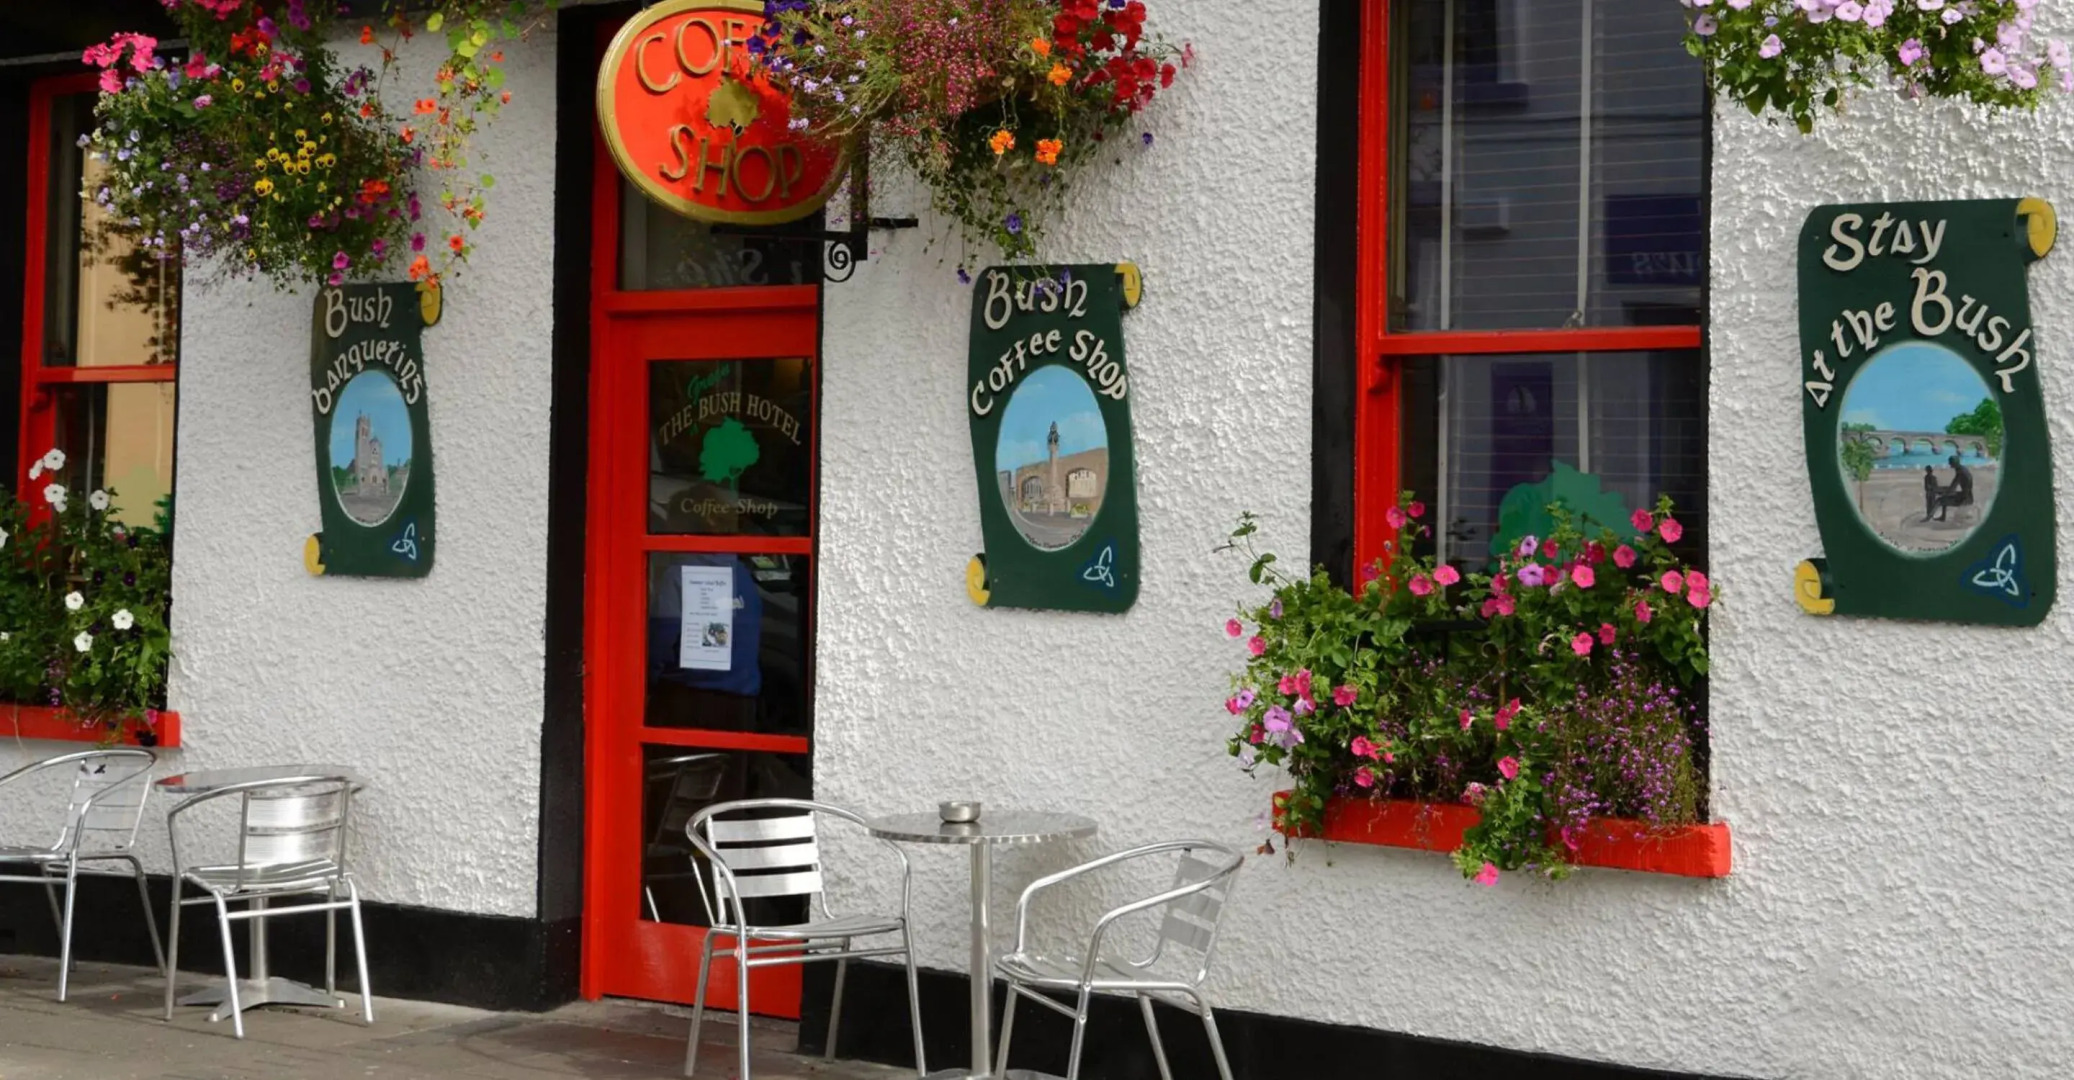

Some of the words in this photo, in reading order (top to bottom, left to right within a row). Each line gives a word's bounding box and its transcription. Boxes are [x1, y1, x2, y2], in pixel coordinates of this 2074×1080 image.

[659, 124, 803, 202] SHOP
[1823, 211, 1947, 271] Stay
[324, 287, 392, 338] Bush
[984, 269, 1088, 330] Bush
[1831, 302, 1897, 358] the
[1910, 267, 2031, 393] Bush
[972, 329, 1063, 415] Coffee
[1069, 329, 1128, 400] Shop
[659, 404, 693, 446] THE
[698, 392, 741, 420] BUSH
[747, 394, 802, 446] HOTEL
[681, 498, 731, 518] Coffee
[736, 498, 778, 519] Shop
